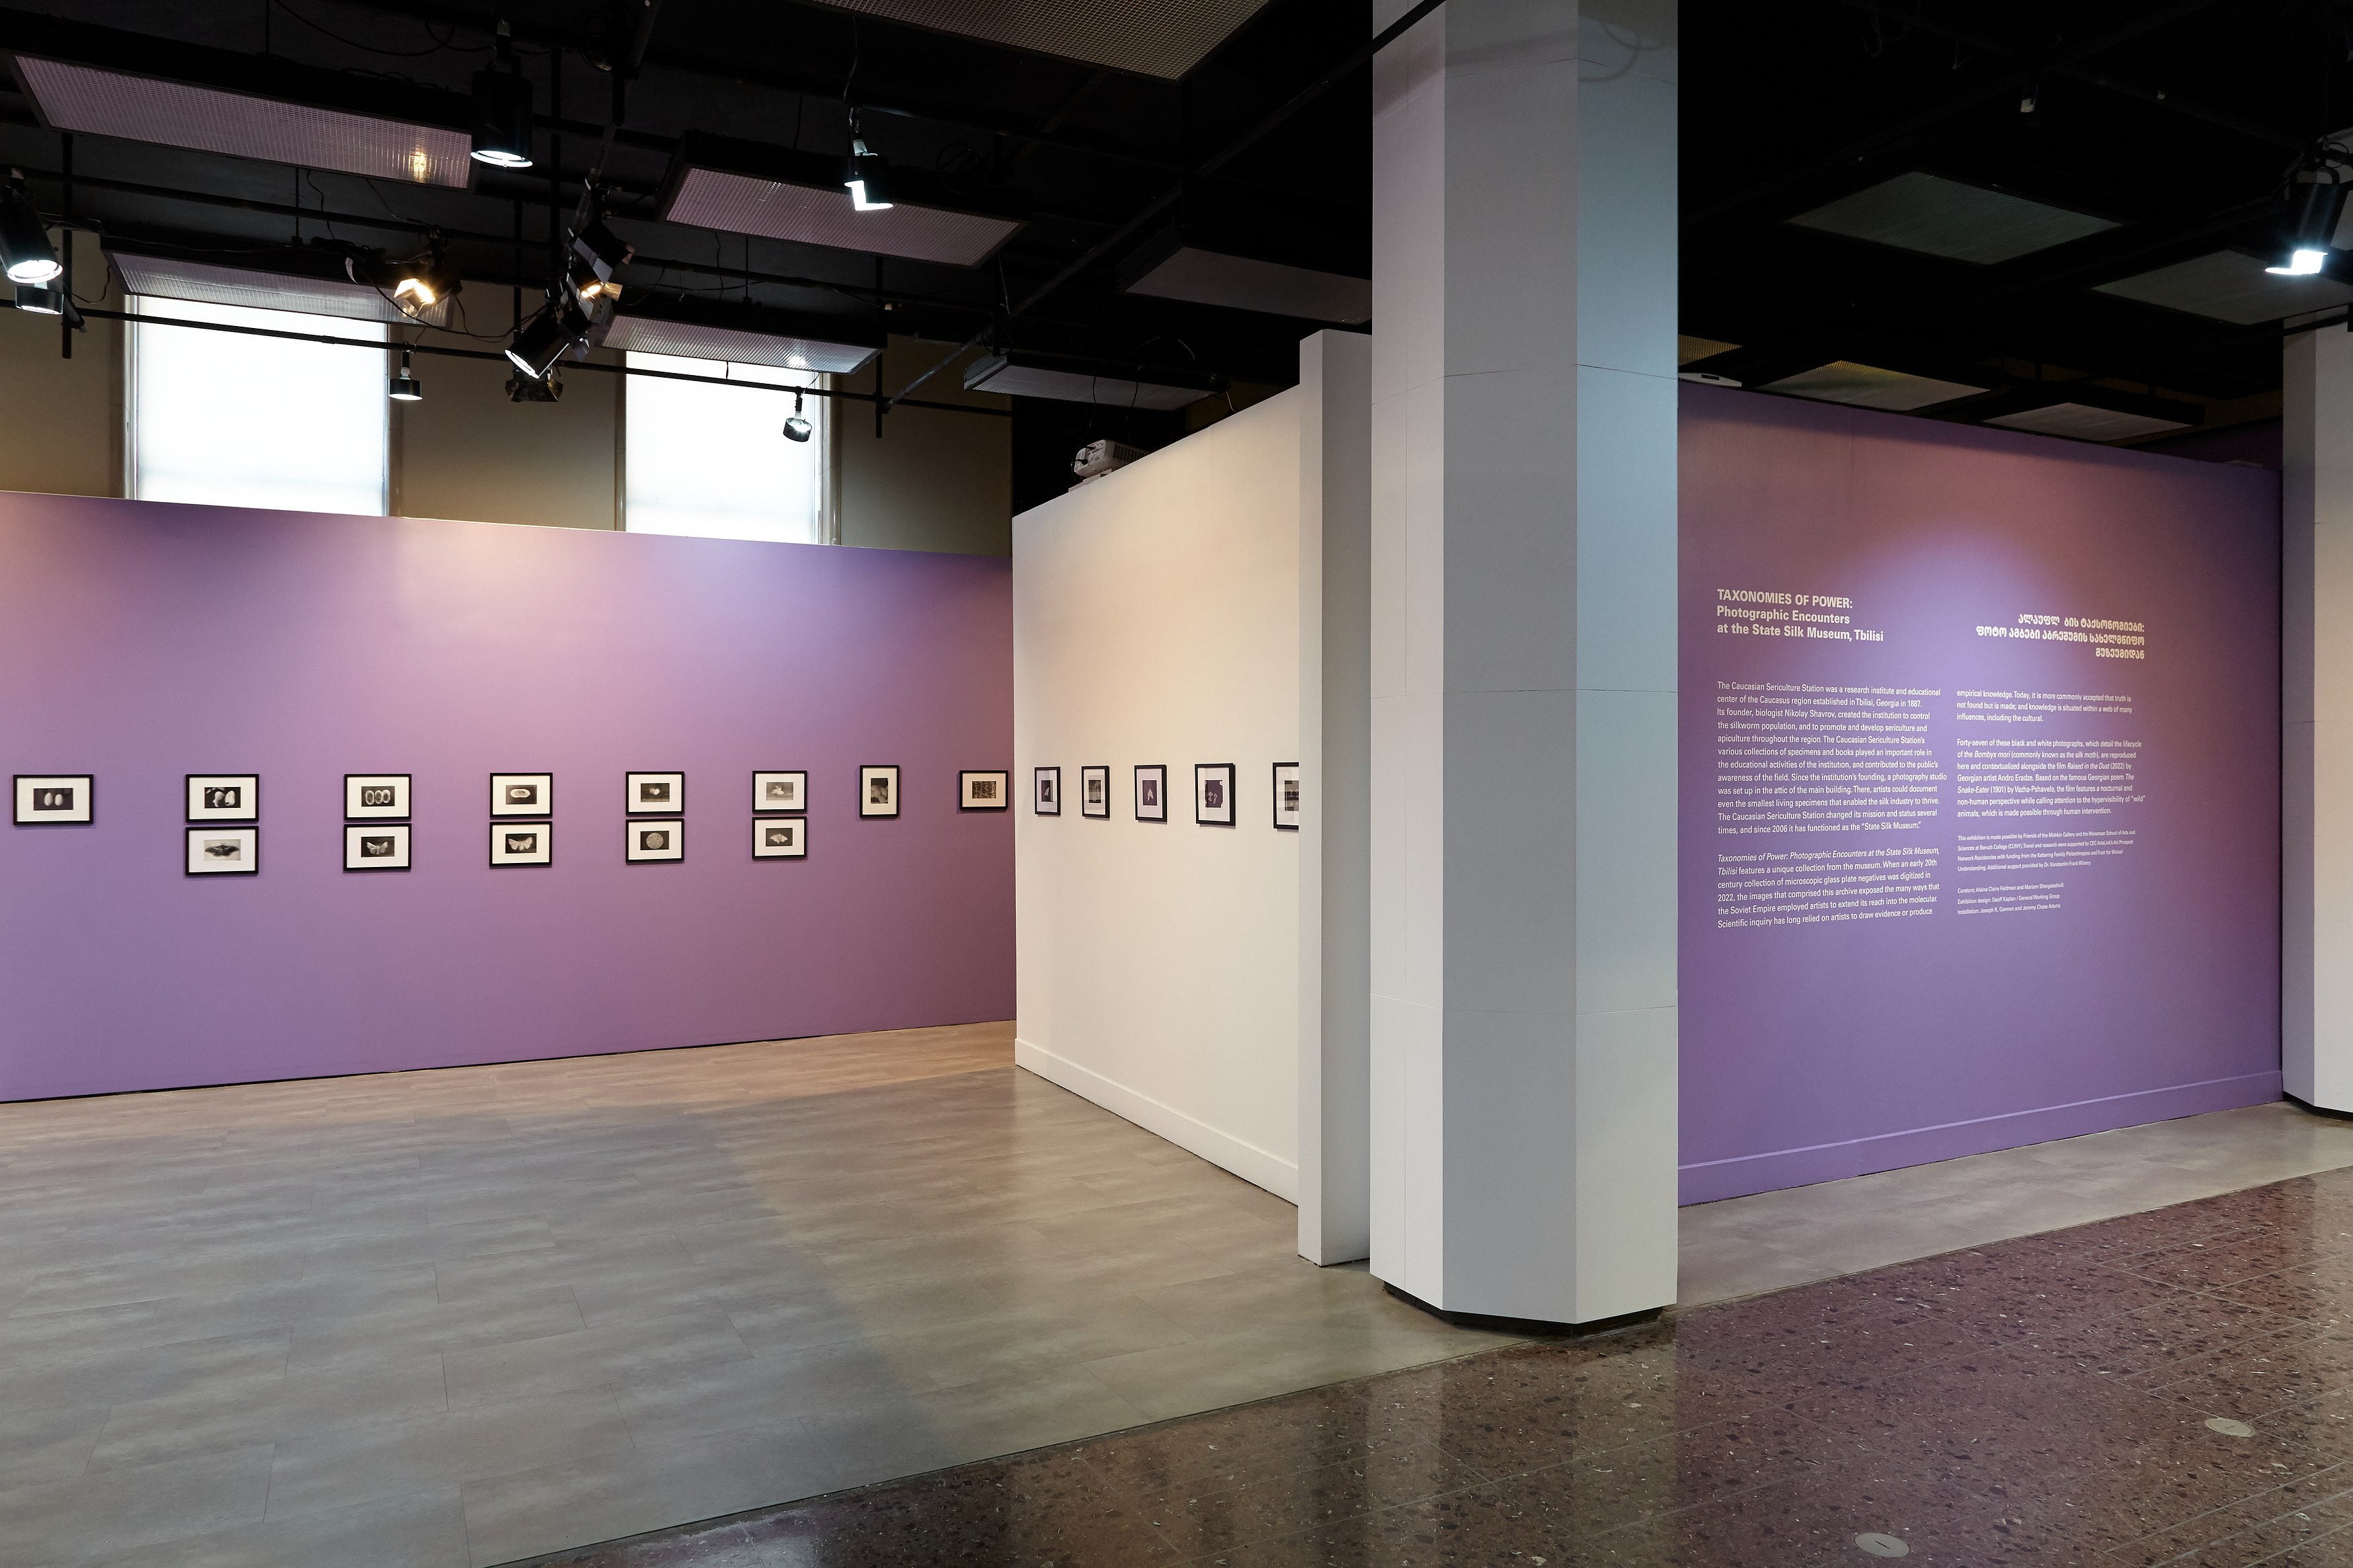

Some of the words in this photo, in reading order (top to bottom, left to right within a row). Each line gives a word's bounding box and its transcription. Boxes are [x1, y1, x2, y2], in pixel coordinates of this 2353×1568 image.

[1717, 588, 1792, 605] TAXONOMIES
[1794, 593, 1809, 606] OF
[1812, 595, 1853, 609] POWER:
[1716, 605, 1789, 622] Photographic
[1792, 610, 1850, 624] Encounters
[1716, 623, 1728, 634] at
[1730, 622, 1749, 634] the
[1752, 623, 1781, 636] State
[1784, 625, 1804, 637] Silk
[1806, 626, 1852, 643] Museum,
[1853, 628, 1884, 642] Tbilisi
[1717, 681, 1730, 690] The
[1731, 682, 1765, 690] Caucasian
[1765, 682, 1800, 692] Sericulture
[1801, 684, 1824, 692] Station
[1844, 686, 1870, 694] research
[1870, 686, 1895, 695] institute
[1895, 687, 1907, 695] and
[1907, 688, 1941, 696] educational
[1956, 689, 1983, 698] empirical
[1983, 690, 2013, 700] knowledge.
[2013, 690, 2031, 700] Today,
[2036, 691, 2042, 699] is
[2056, 693, 2082, 702] commonly
[2082, 694, 2104, 702] accepted
[2104, 694, 2114, 702] that
[1717, 707, 1725, 716] Its
[1726, 707, 1754, 717] founder,
[1755, 708, 1784, 718] biologist
[1784, 708, 1808, 719] Nikolay
[1809, 709, 1837, 719] Shavrov,
[1837, 710, 1861, 718] created
[1861, 710, 1872, 718] the
[1872, 710, 1902, 719] institution
[1909, 712, 1930, 720] control
[1956, 712, 1986, 722] influences,
[1987, 713, 2011, 723] including
[2012, 714, 2022, 722] the
[1957, 750, 1964, 758] of
[1964, 750, 1973, 758] the
[1974, 750, 1997, 759] Bombyx
[1997, 750, 2011, 758] mori
[2011, 750, 2041, 759] (commonly
[2083, 751, 2100, 759] moth),
[2109, 751, 2137, 759] reproduced
[1753, 773, 1761, 782] of
[1761, 773, 1773, 782] the
[1773, 773, 1790, 781] field.
[1791, 773, 1809, 781] Since
[1810, 773, 1821, 781] the
[1858, 772, 1886, 782] founding,
[1892, 772, 1929, 782] photography
[1929, 772, 1947, 780] studio
[1957, 774, 1983, 783] Georgian
[1983, 774, 1997, 782] artist
[1997, 774, 2014, 782] Andro
[2015, 774, 2034, 782] Eradze.
[2068, 773, 2087, 781] famous
[2087, 773, 2110, 782] Georgian
[1735, 799, 1747, 808] the
[1747, 799, 1774, 807] smallest
[1776, 798, 1794, 809] living
[1794, 798, 1828, 808] specimens
[1829, 798, 1841, 806] that
[1842, 797, 1867, 806] enabled
[1868, 797, 1878, 805] the
[1878, 797, 1889, 805] silk
[1889, 797, 1913, 806] industry
[1921, 796, 1940, 804] thrive.
[1718, 826, 1739, 835] times,
[1739, 825, 1753, 834] and
[1753, 825, 1771, 833] since
[1771, 824, 1788, 833] 2006
[1788, 824, 1794, 833] it
[1794, 824, 1806, 832] has
[1806, 823, 1840, 832] functioned
[1849, 823, 1860, 831] the
[1880, 822, 1892, 830] Silk
[1718, 853, 1757, 862] Taxonomies
[1758, 852, 1766, 861] of
[1766, 852, 1788, 860] Power:
[1789, 850, 1831, 861] Photographic
[1832, 850, 1867, 858] Encounters
[1874, 848, 1885, 856] the
[1885, 848, 1901, 856] State
[1901, 847, 1913, 856] Silk
[1913, 847, 1940, 856] Museum,
[1717, 881, 1743, 890] century
[1744, 878, 1776, 888] collection
[1776, 877, 1784, 886] of
[1784, 876, 1823, 886] microscopic
[1823, 875, 1840, 885] glass
[1841, 874, 1857, 884] plate
[1858, 873, 1886, 883] negatives
[1899, 871, 1924, 881] digitized
[1924, 870, 1931, 878] in
